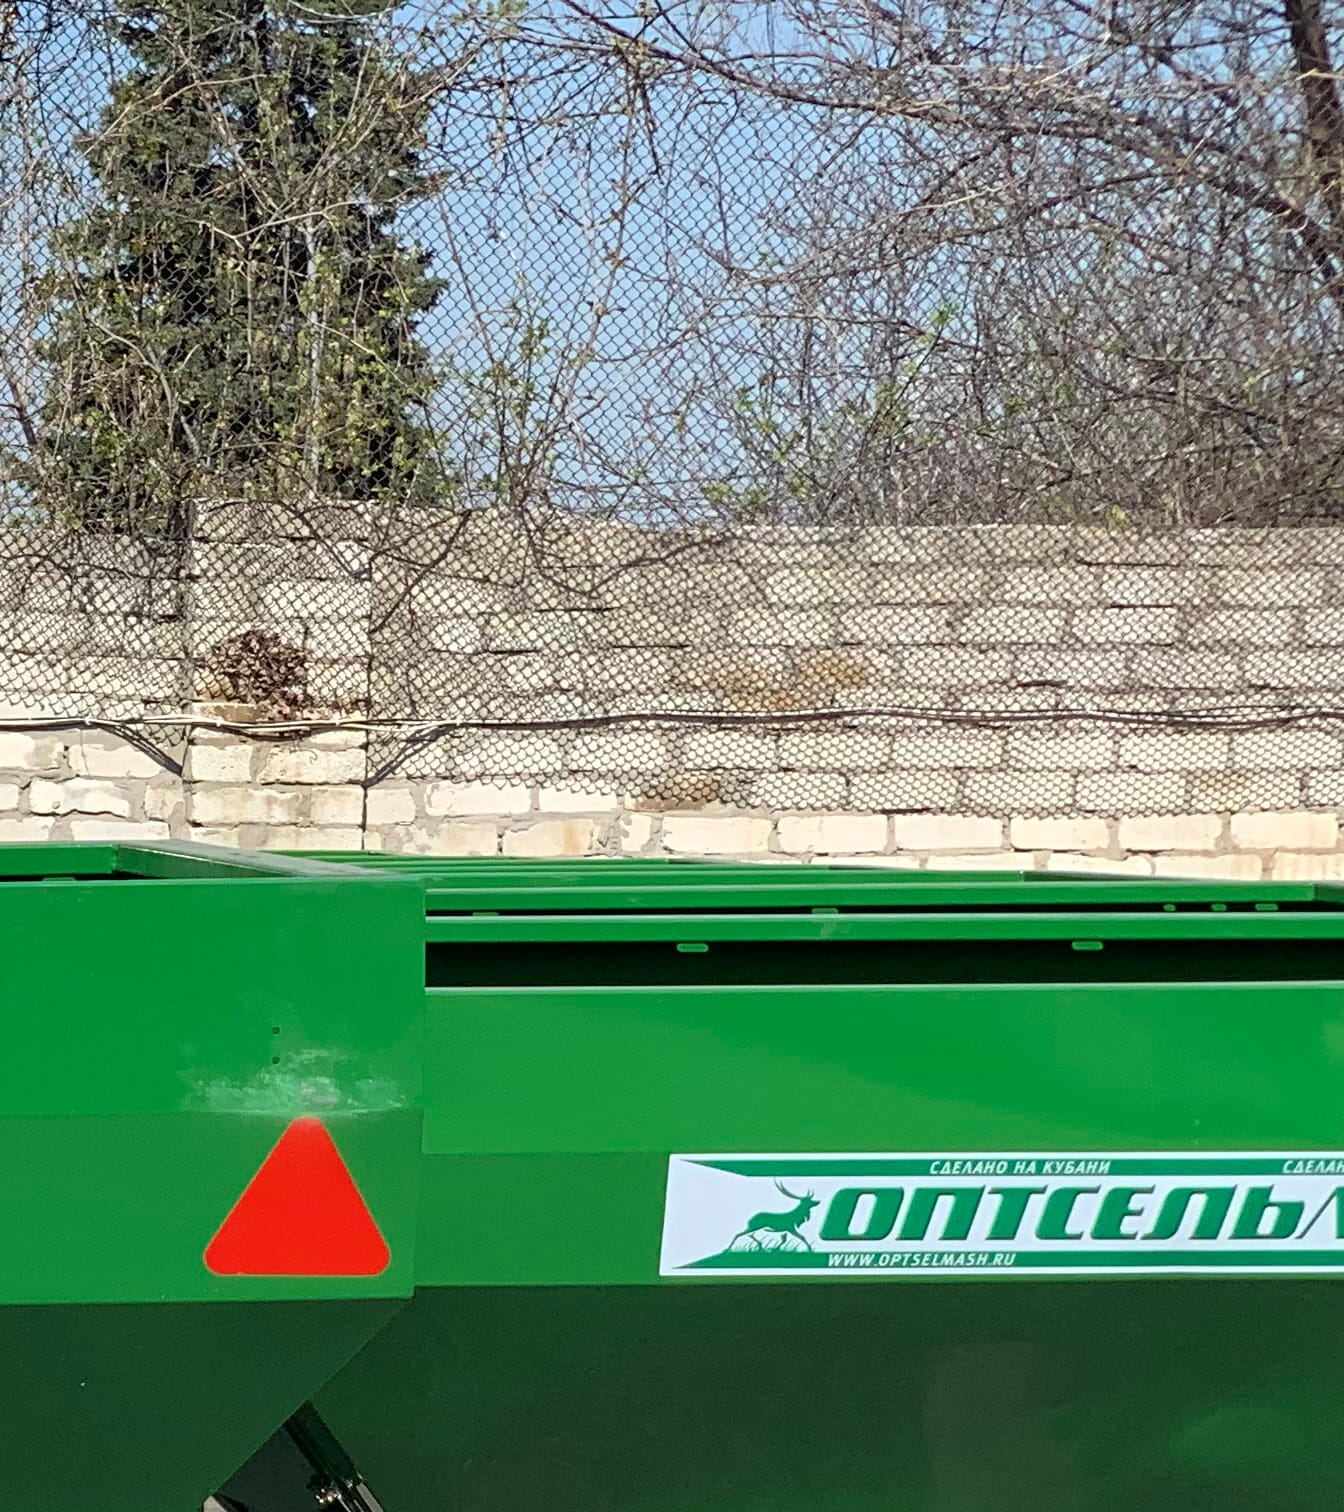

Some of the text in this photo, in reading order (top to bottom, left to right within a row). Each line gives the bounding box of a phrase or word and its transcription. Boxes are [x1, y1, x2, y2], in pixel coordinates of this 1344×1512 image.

[929, 1160, 1112, 1175] СДЕЛАНО НА КУБАНИ
[827, 1252, 1016, 1267] WWW.OPTSELMASH.RU
